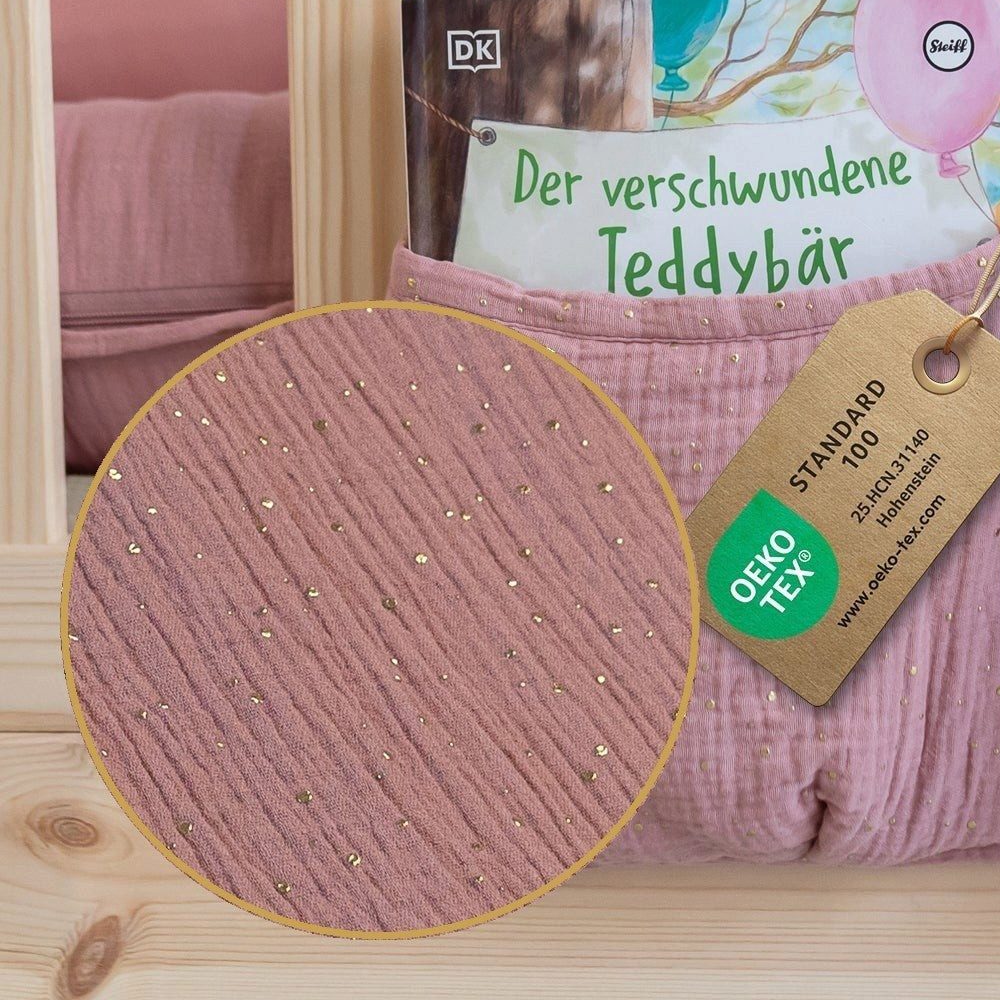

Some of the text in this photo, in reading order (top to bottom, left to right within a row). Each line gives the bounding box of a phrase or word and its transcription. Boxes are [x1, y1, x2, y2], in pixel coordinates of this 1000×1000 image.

[455, 39, 495, 61] DK
[929, 38, 968, 54] Steiff
[513, 145, 912, 212] Der verschwundene
[598, 225, 854, 297] Teddybär
[789, 378, 886, 494] STANDARD
[841, 428, 880, 471] 100
[850, 427, 930, 525] 25.HCN.31140
[876, 451, 942, 529] Hohenstein
[730, 529, 796, 603] OEKO
[837, 493, 947, 630] www.oeko-tex.com
